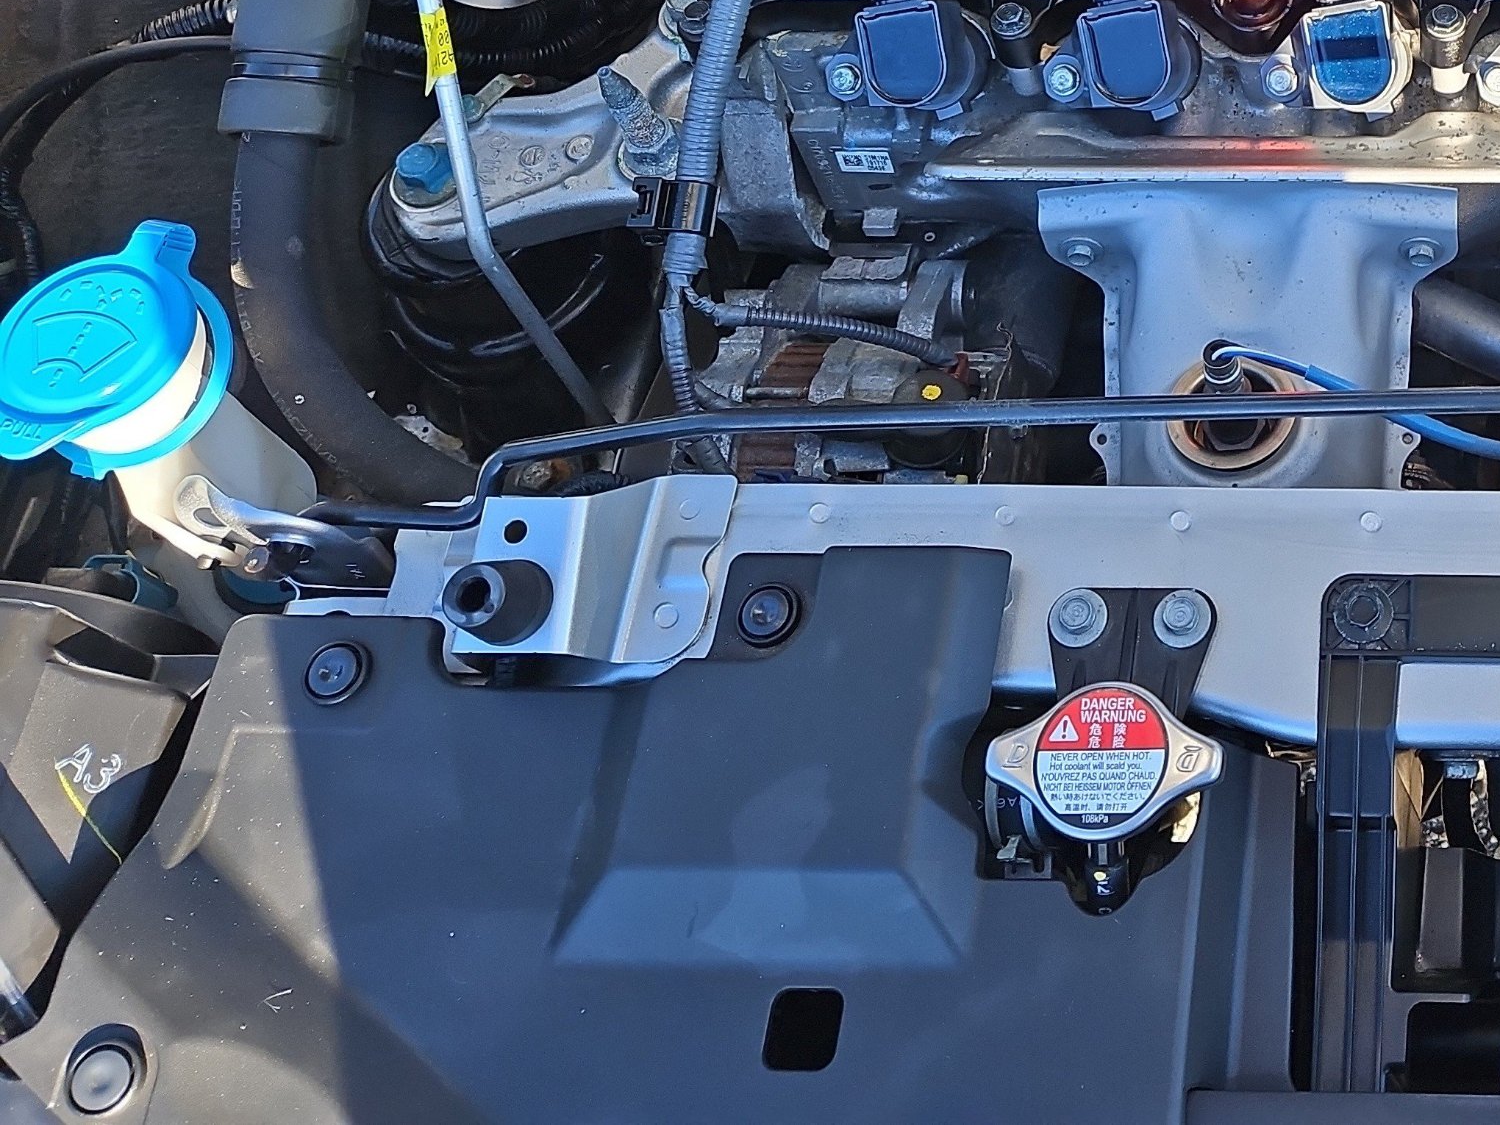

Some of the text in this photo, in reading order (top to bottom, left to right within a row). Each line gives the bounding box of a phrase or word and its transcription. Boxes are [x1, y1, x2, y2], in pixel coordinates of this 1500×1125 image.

[1081, 697, 1134, 710] DANGER
[1081, 710, 1146, 722] WARNUNG
[1051, 752, 1151, 761] NEVER OPEN WHEN HOT.
[54, 743, 121, 794] A3
[1050, 762, 1142, 771] Hot coolant will scald you.
[1041, 772, 1157, 781] N'OUVREZ PAS QUAND CHAUD.
[1044, 783, 1062, 791] NICHT
[1063, 783, 1074, 791] BEI
[1075, 783, 1102, 791] HEISSEM
[1103, 782, 1125, 791] MOTOR
[1081, 815, 1108, 823] 108kPa
